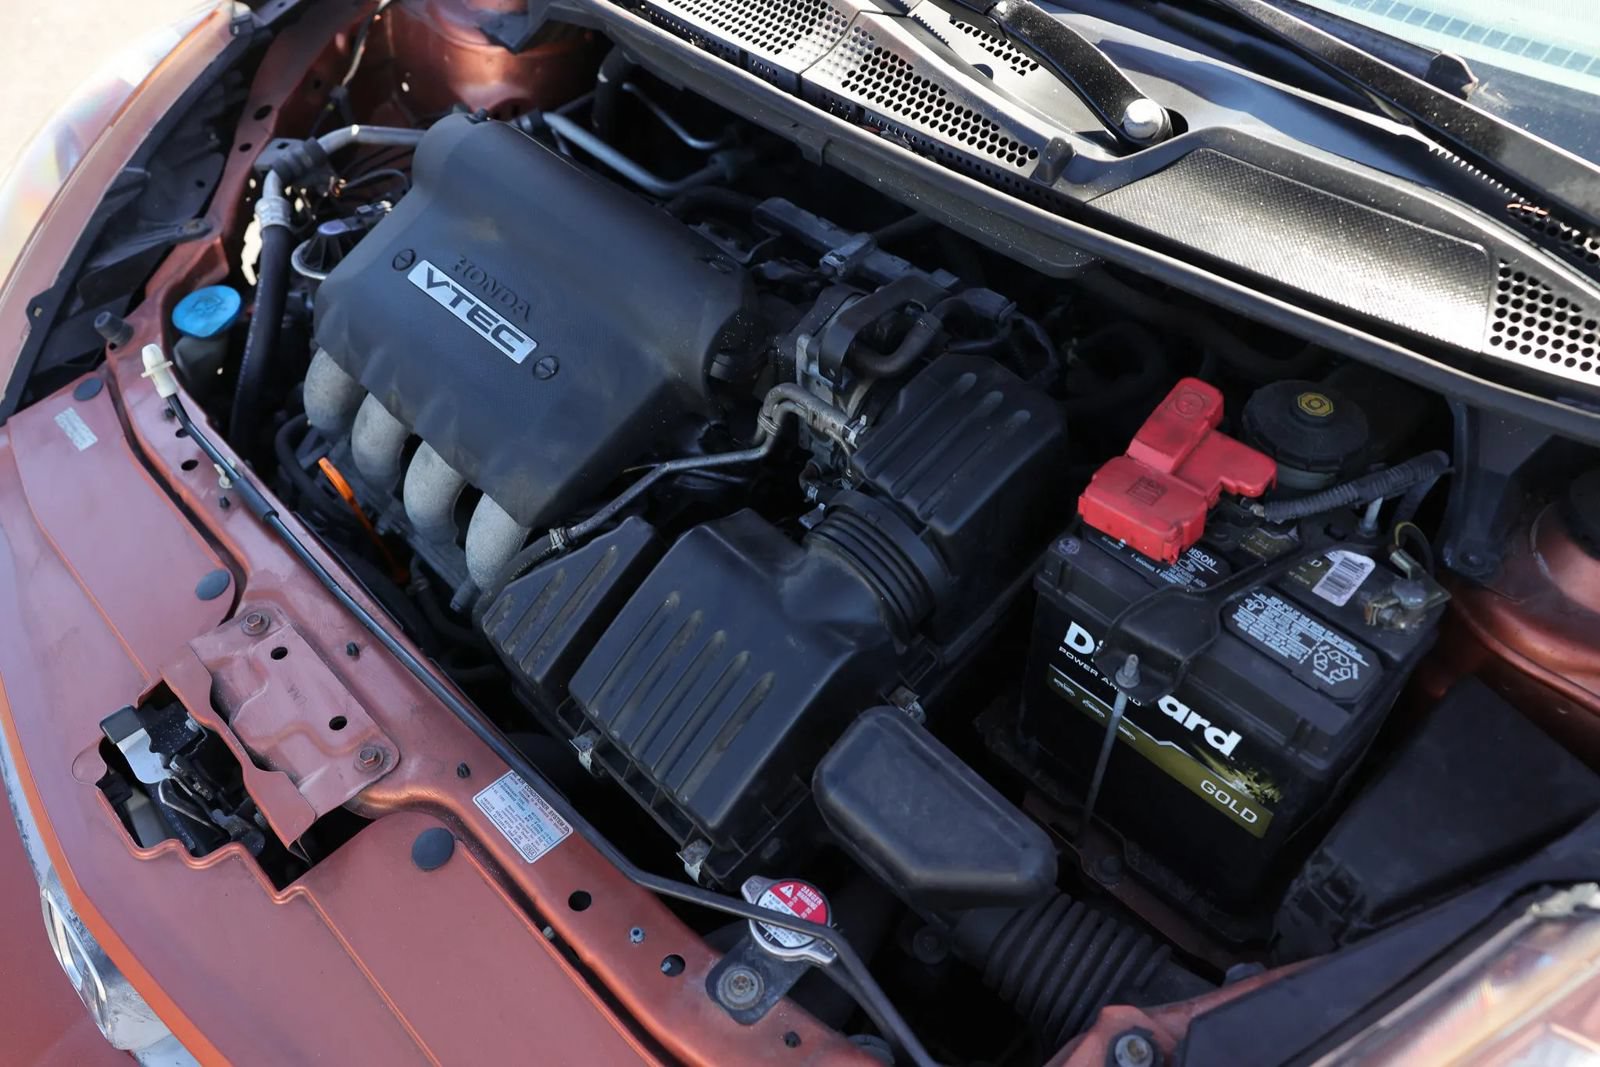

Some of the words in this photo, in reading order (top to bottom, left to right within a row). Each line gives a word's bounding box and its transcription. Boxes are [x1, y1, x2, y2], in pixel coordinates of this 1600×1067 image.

[453, 254, 532, 322] HONDA
[426, 265, 526, 355] VTEC
[1188, 547, 1217, 567] ISON
[1058, 645, 1099, 678] POWER
[1101, 676, 1142, 707] AHD
[524, 784, 550, 812] CONDITIONER
[1200, 779, 1258, 824] GOLD
[801, 885, 823, 906] DANGER
